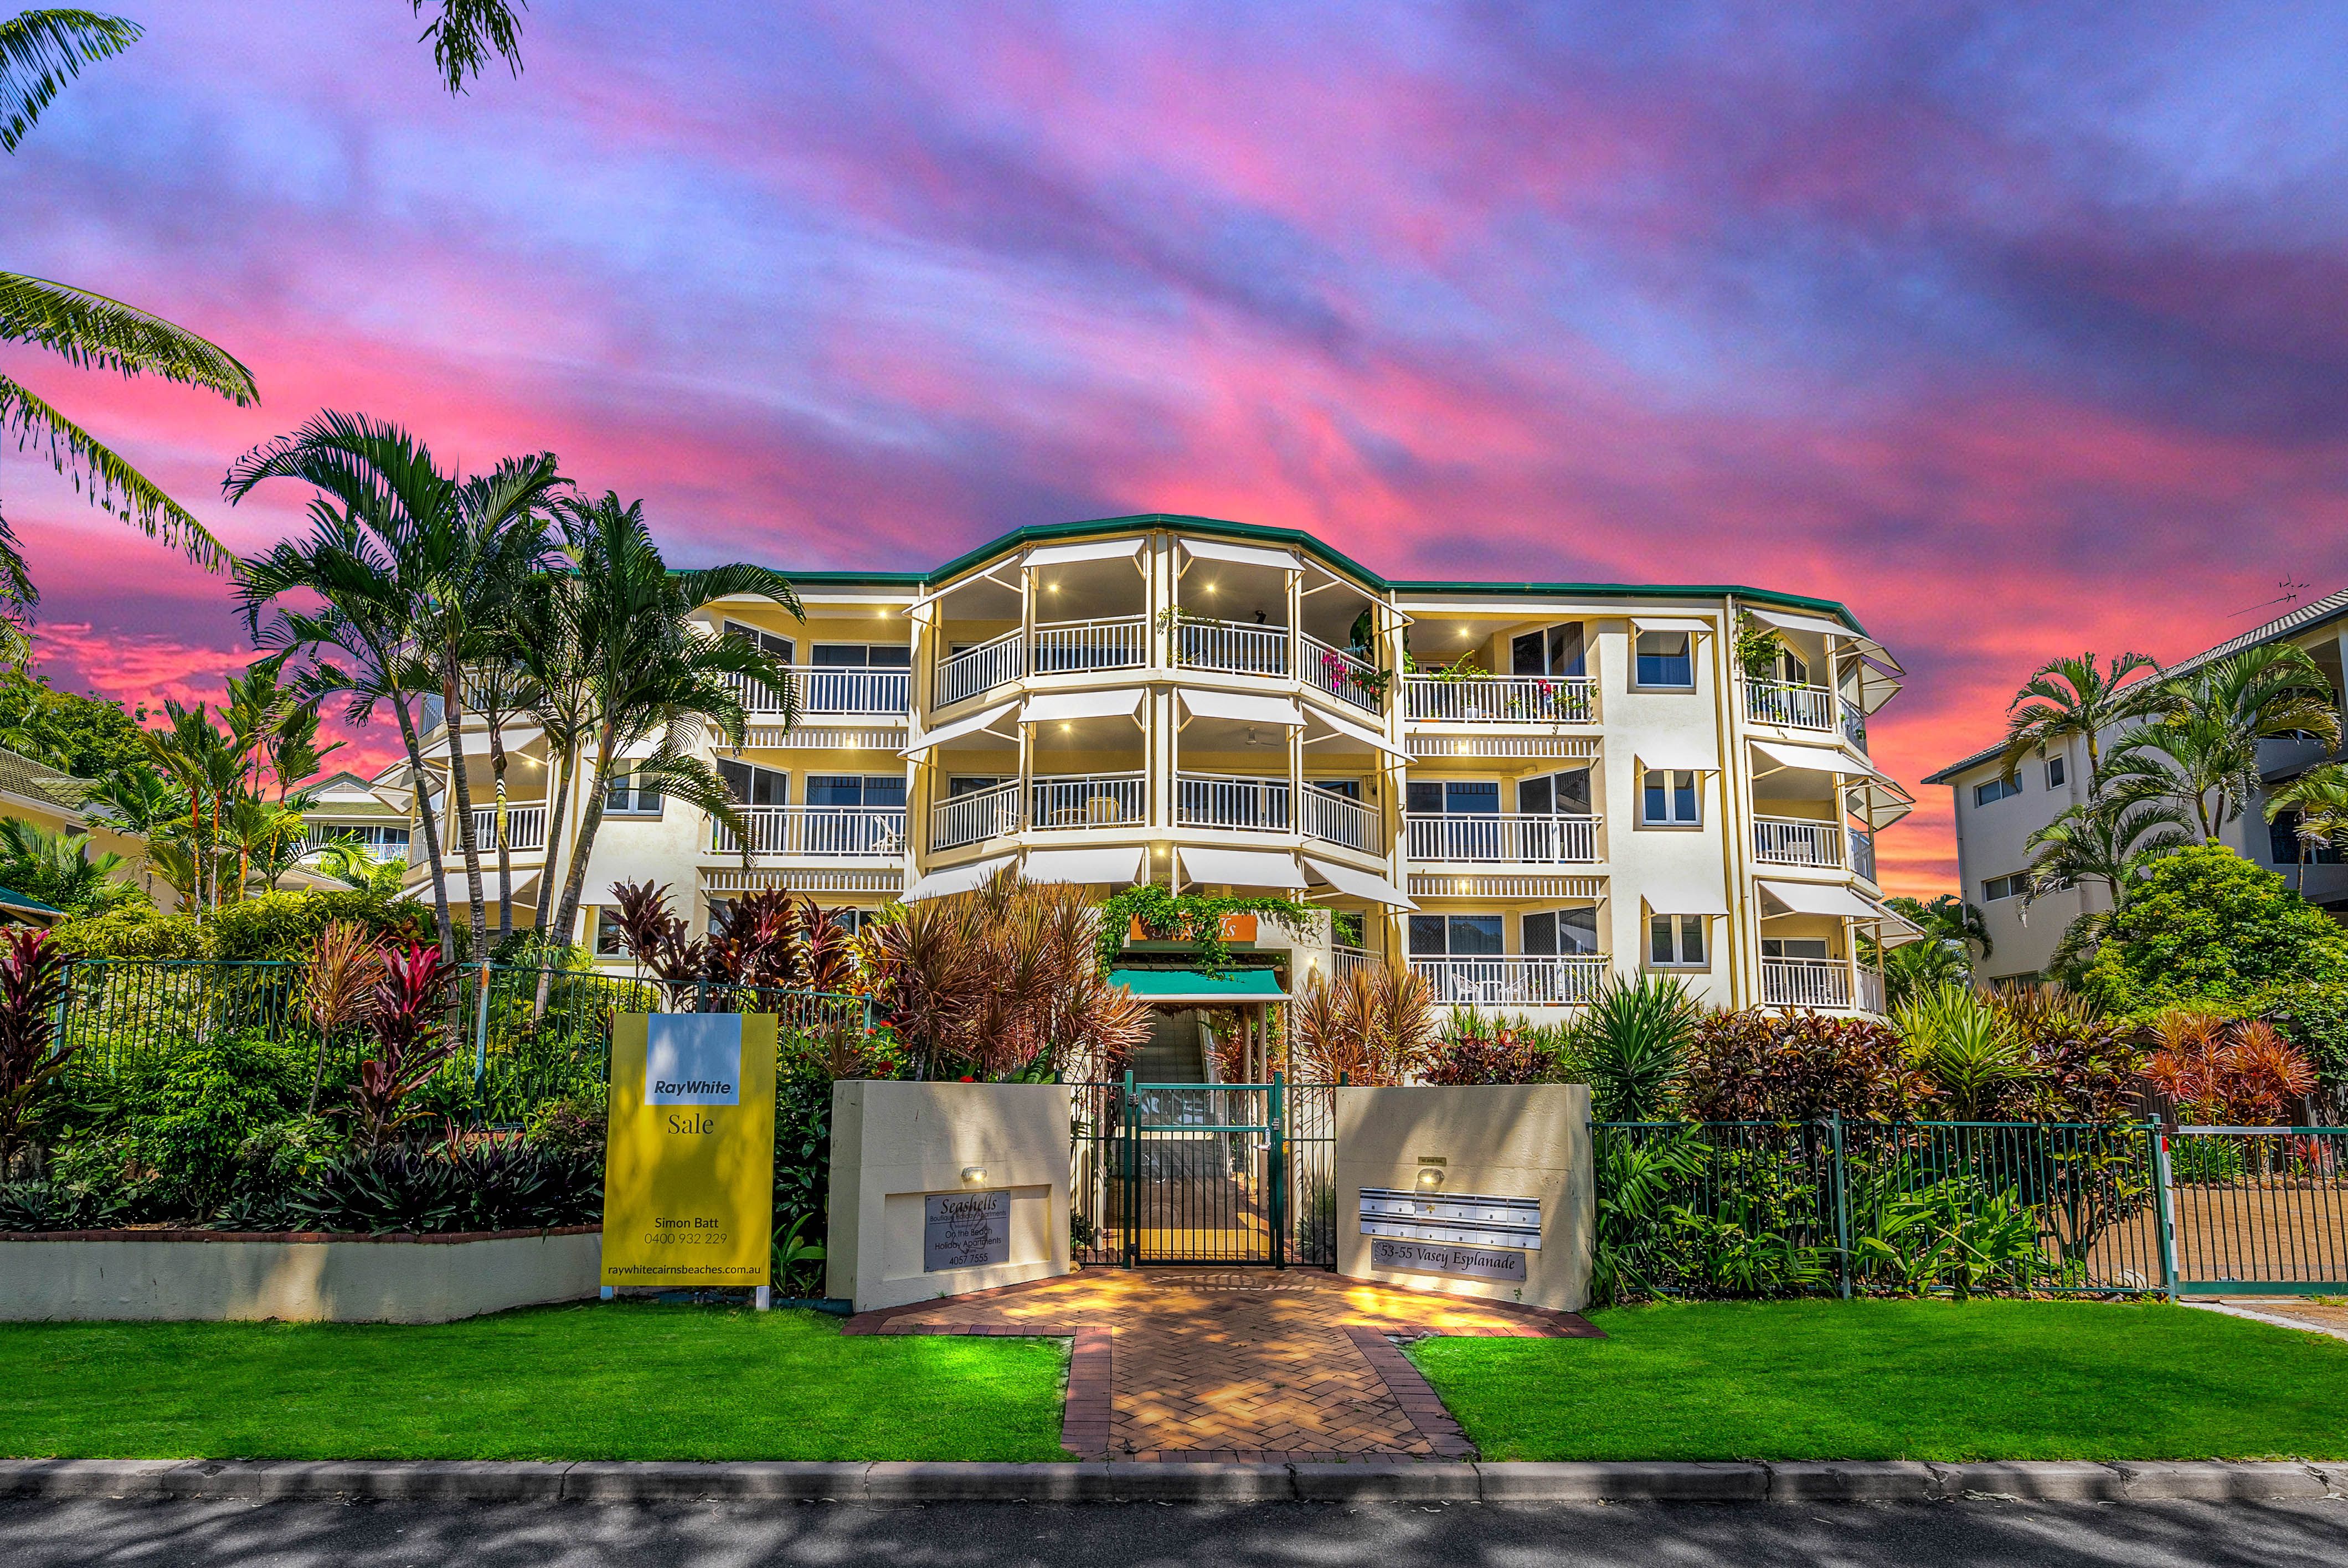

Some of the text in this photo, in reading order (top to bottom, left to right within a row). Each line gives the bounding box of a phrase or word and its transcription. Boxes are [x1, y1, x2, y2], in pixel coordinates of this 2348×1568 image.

[1152, 917, 1237, 937] easls
[655, 1081, 732, 1096] RayWhite
[668, 1113, 714, 1134] Sale
[941, 1193, 997, 1214] Seashells
[655, 1218, 719, 1228] Simon Batt
[645, 1233, 727, 1244] 0400 932 229
[971, 1227, 992, 1236] Beach
[935, 1236, 1002, 1250] Holiday Apartments
[949, 1253, 988, 1266] 4057 7555
[1381, 1245, 1515, 1270] 53-55 Vasey Esplanade
[608, 1265, 761, 1276] raywhitecairnsbeaches.com.au
